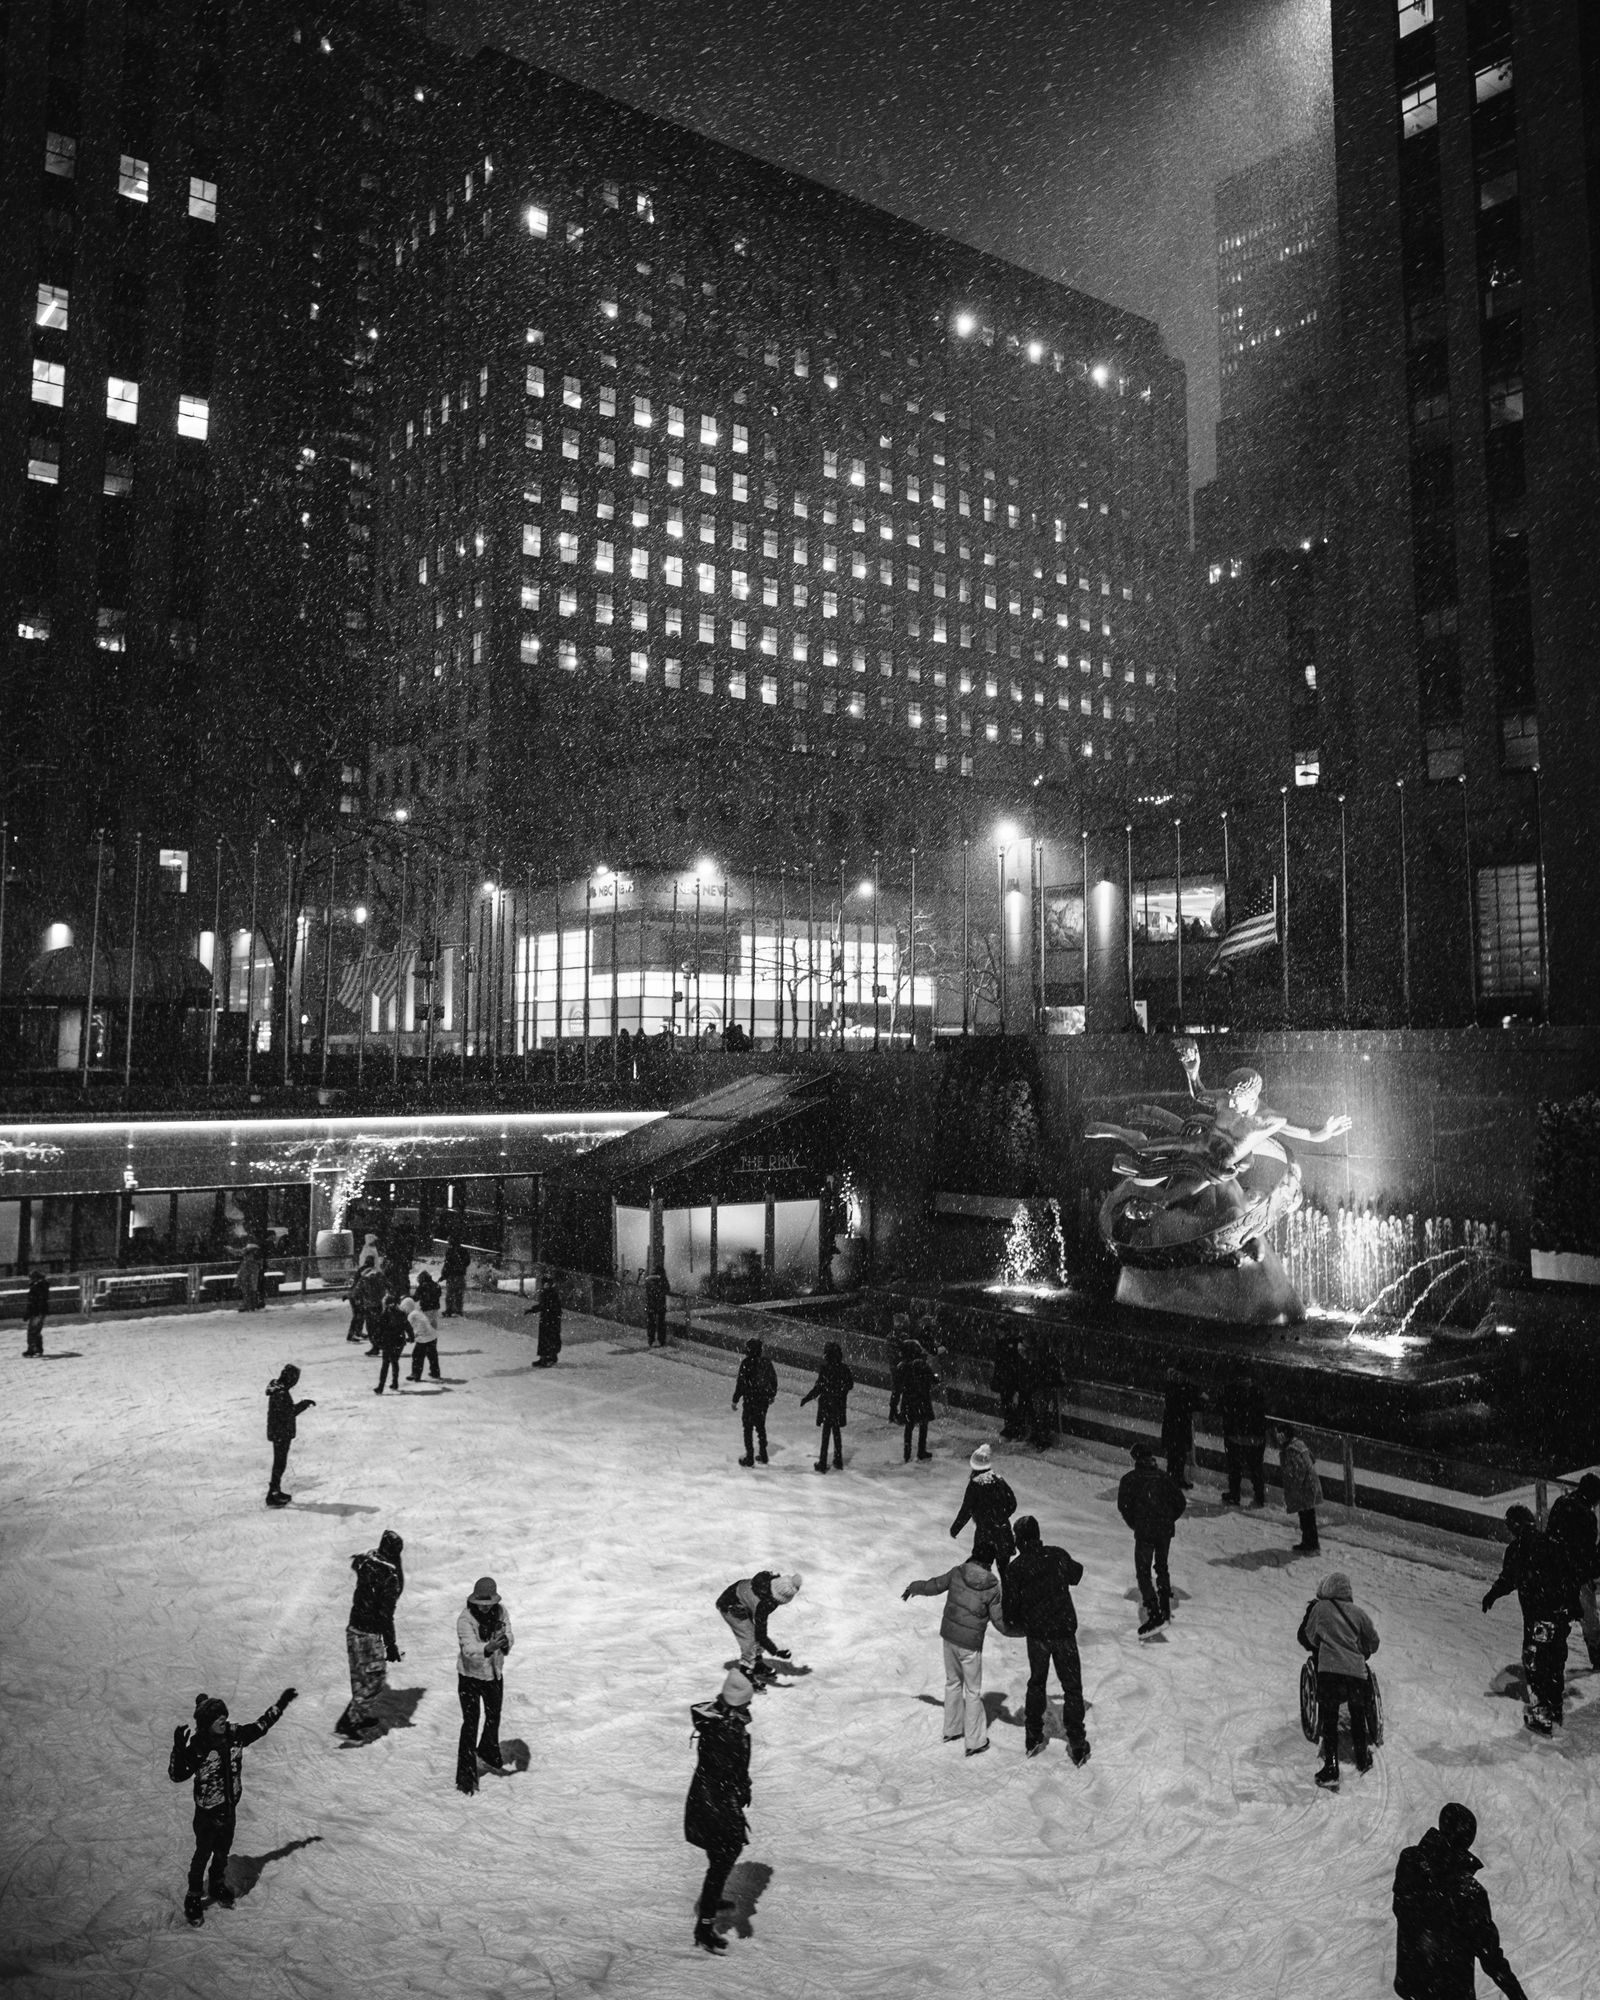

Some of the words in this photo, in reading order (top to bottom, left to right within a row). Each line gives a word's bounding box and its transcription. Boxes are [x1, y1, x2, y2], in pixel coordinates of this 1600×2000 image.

[598, 884, 613, 897] NBC
[741, 1155, 763, 1170] THE
[769, 1153, 800, 1169] RINK
